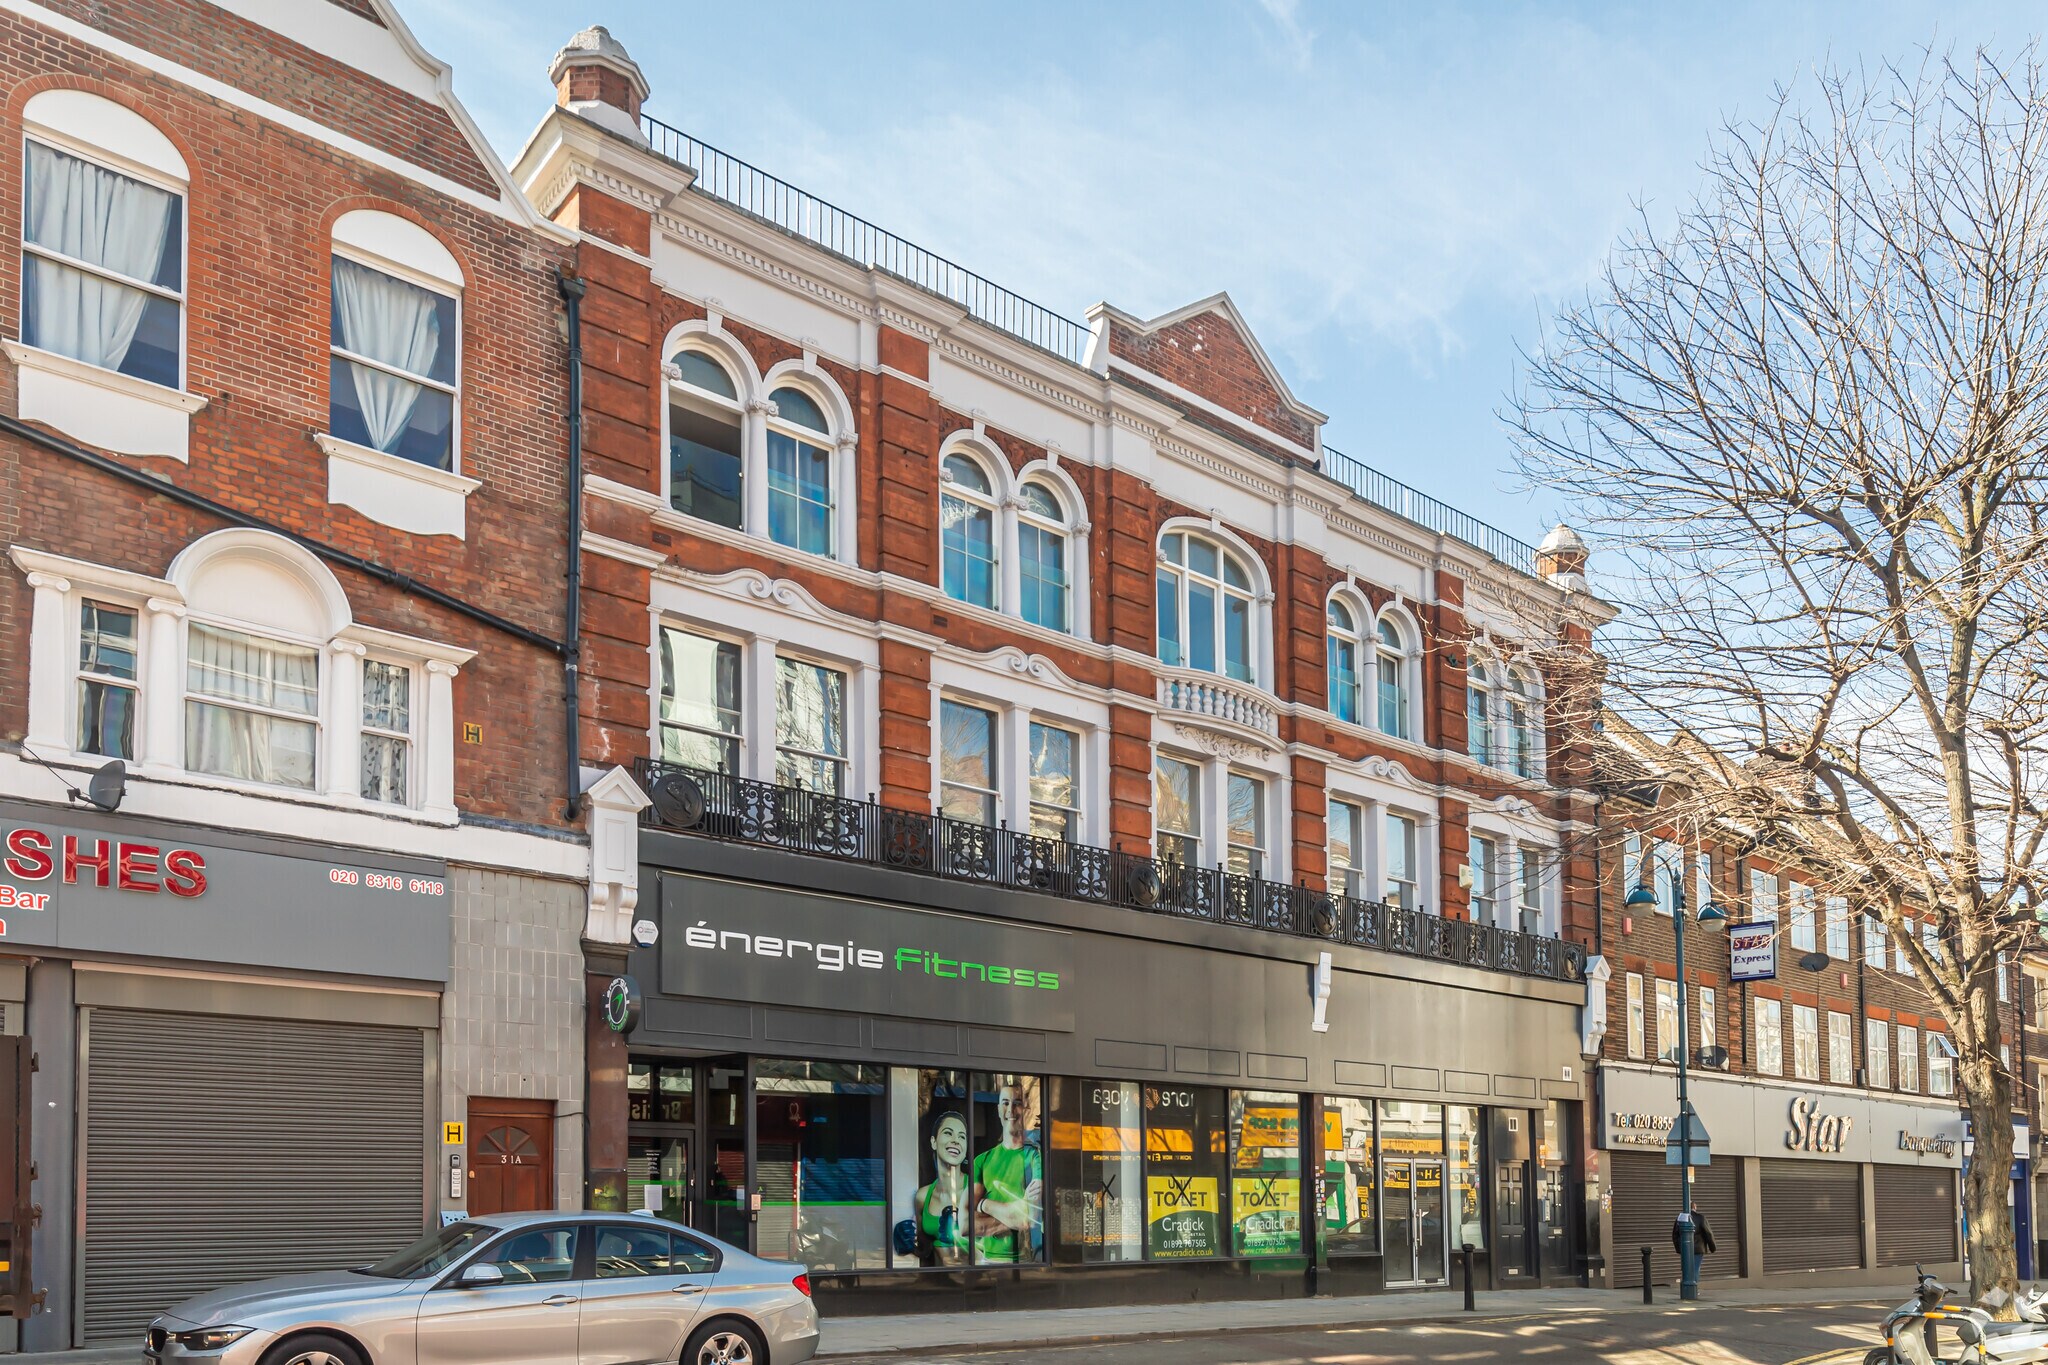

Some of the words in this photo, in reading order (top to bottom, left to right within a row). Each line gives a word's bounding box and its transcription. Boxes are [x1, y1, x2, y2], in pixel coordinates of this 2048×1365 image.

[0, 828, 208, 898] SHES
[329, 868, 359, 886] 020
[365, 873, 402, 891] 8316
[409, 879, 444, 896] 6118
[0, 884, 51, 911] Bar
[685, 920, 884, 972] énergie
[1733, 954, 1771, 965] Express
[1614, 1112, 1632, 1128] Tel:
[1634, 1113, 1651, 1129] 020
[1652, 1115, 1674, 1131] 8855
[1782, 1096, 1853, 1153] Star
[447, 1125, 461, 1142] H
[501, 1154, 522, 1165] 31A
[1154, 1191, 1176, 1207] TO
[1240, 1192, 1261, 1207] TO
[1162, 1217, 1205, 1232] Cradick
[1246, 1216, 1285, 1231] Cradick
[1154, 1247, 1214, 1257] www.cradick.co.uk
[1163, 1240, 1183, 1249] 01892
